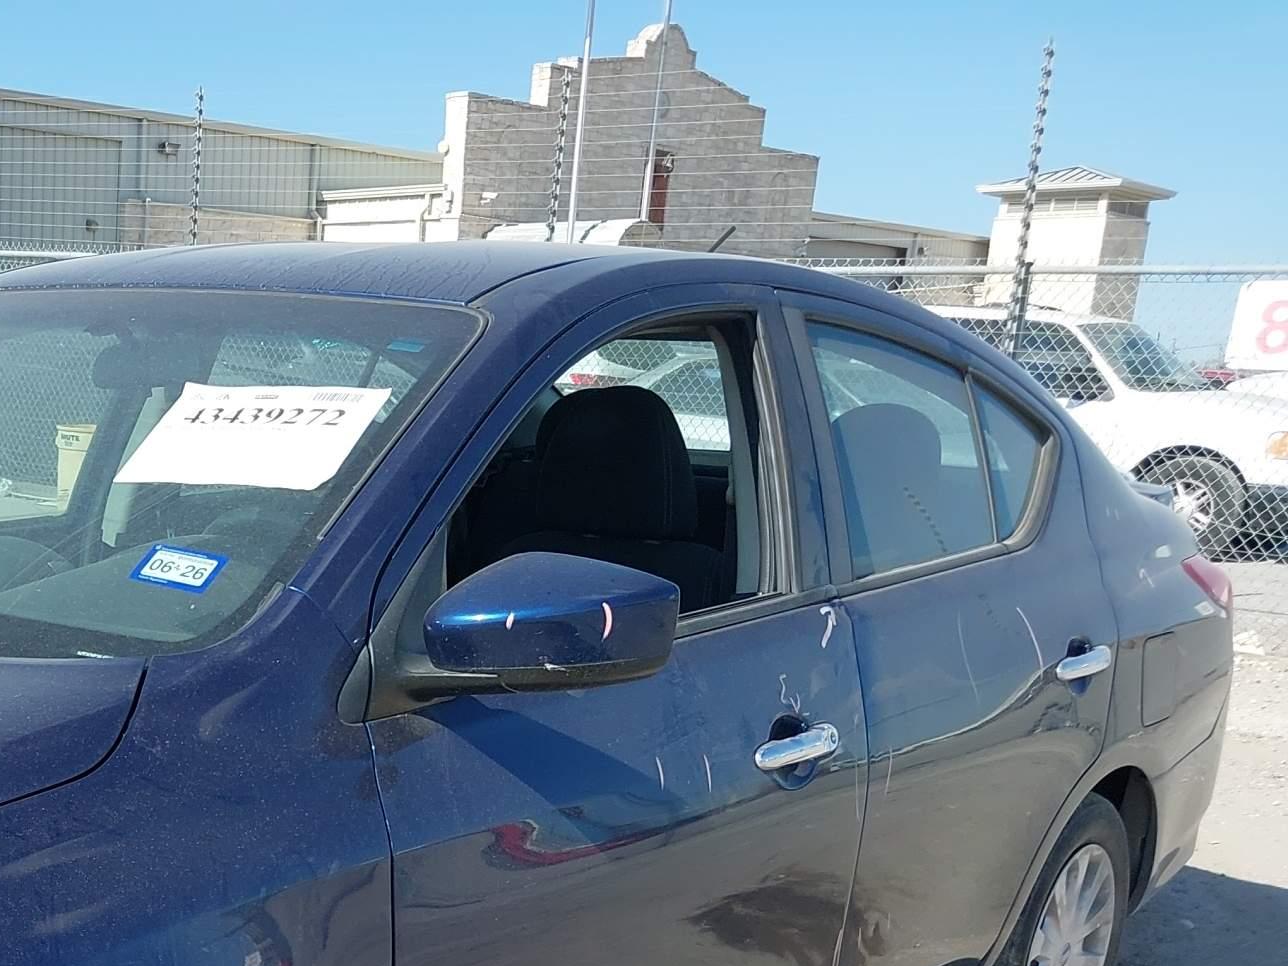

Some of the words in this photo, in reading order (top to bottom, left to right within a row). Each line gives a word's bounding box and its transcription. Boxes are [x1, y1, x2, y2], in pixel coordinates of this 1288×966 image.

[1255, 299, 1288, 355] 8
[184, 407, 346, 427] 43439272
[149, 558, 175, 574] 06
[179, 564, 208, 580] 26
